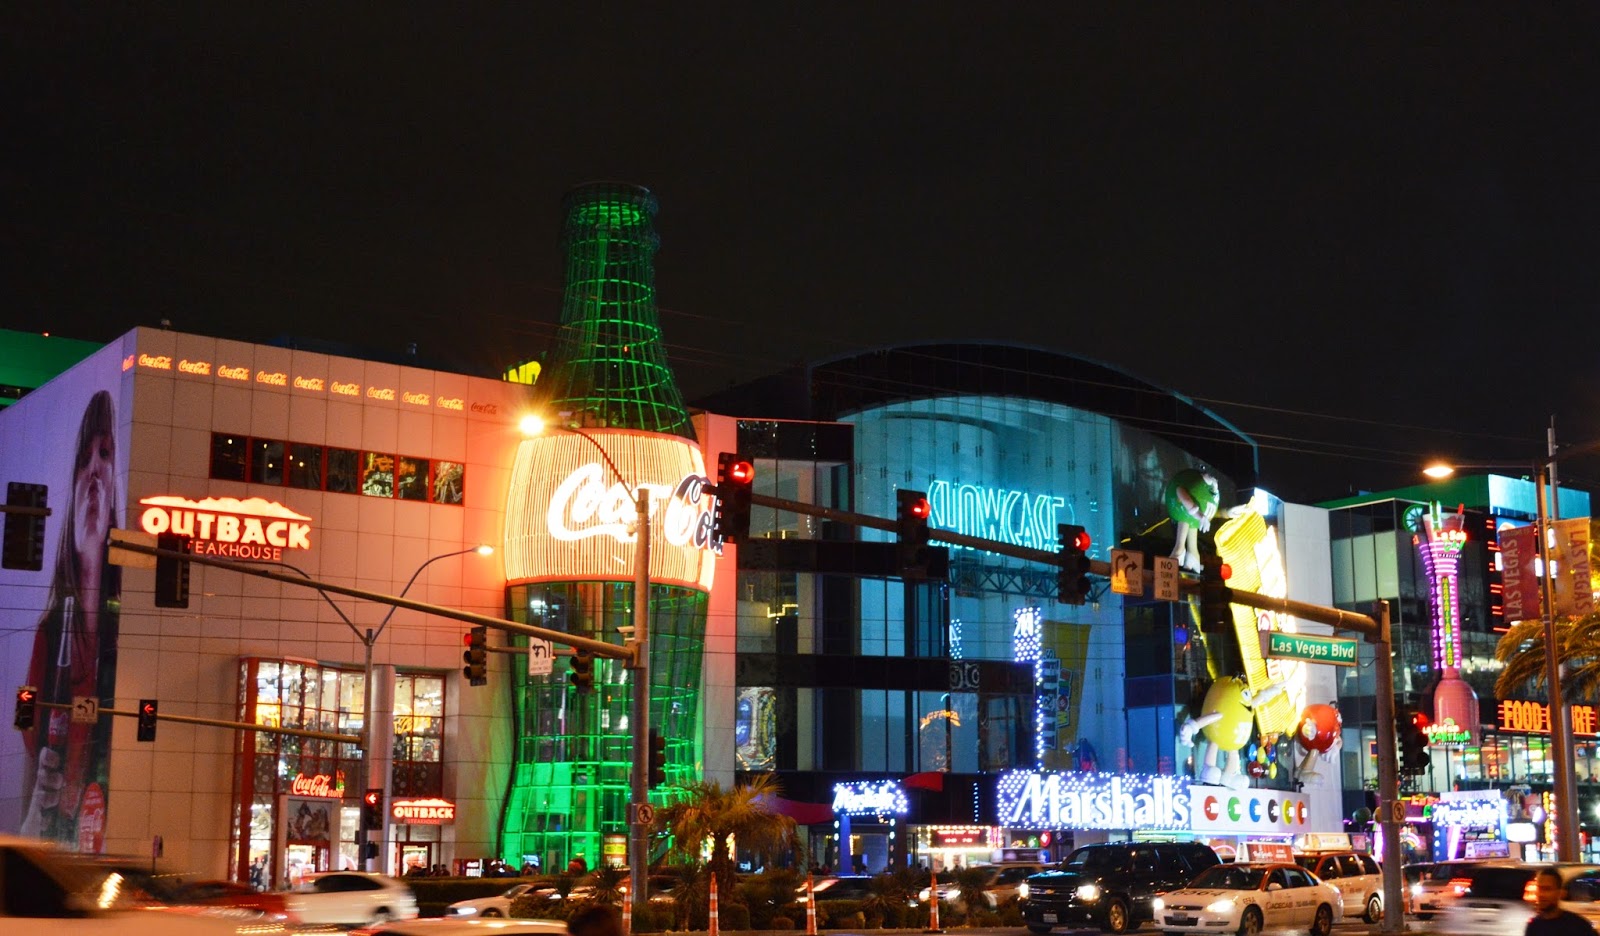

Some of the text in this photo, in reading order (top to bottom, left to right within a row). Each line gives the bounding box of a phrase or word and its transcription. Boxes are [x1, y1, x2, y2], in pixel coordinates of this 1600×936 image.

[141, 507, 313, 550] OUTBACK
[1160, 561, 1173, 570] NO
[1502, 538, 1521, 589] VEGAS
[1572, 560, 1592, 610] VEGAS
[1505, 590, 1523, 619] LAS
[1271, 637, 1355, 659] Las Vegas Blvd
[1503, 699, 1542, 731] FOOD
[393, 807, 454, 819] OUTBACK
[1011, 773, 1189, 826] Marshalls
